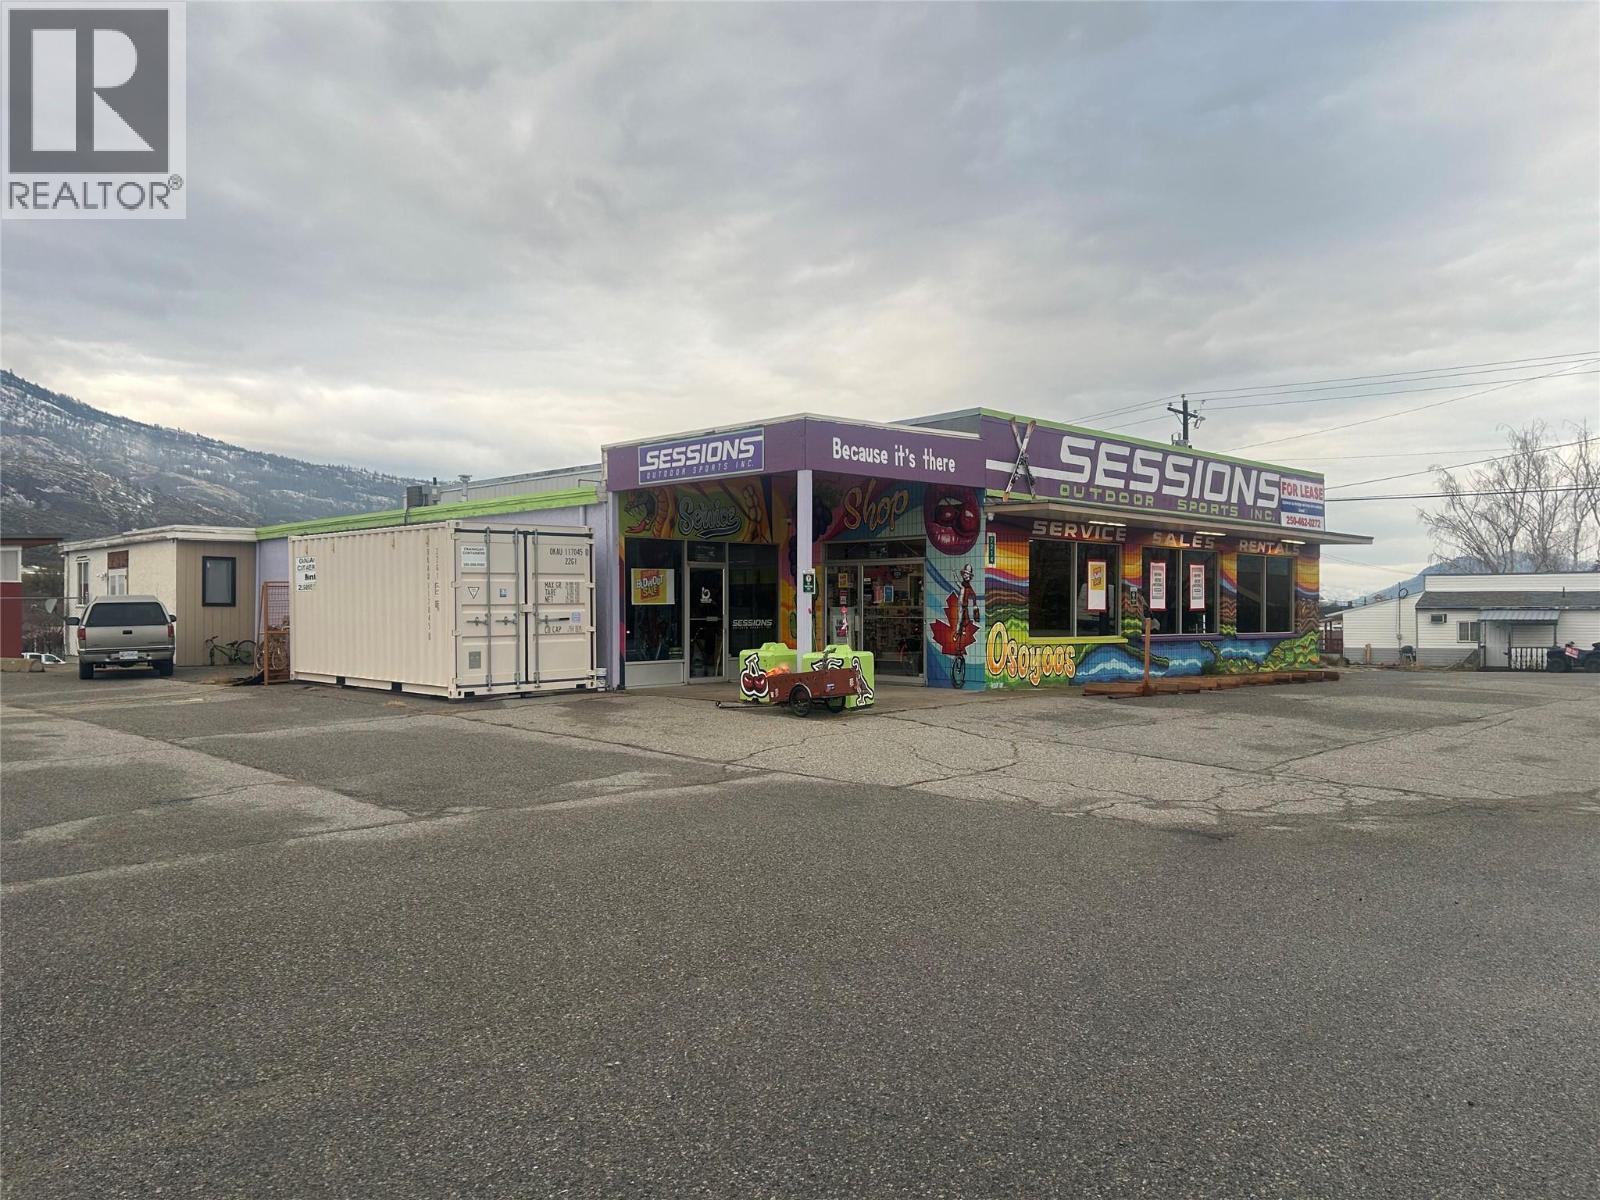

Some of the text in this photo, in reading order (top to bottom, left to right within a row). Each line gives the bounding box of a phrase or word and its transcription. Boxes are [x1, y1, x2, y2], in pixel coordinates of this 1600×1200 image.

[640, 436, 763, 471] SESSIONS
[832, 437, 956, 473] Because it's there
[646, 459, 755, 480] OUTDOOR SPORTS INC.
[1058, 434, 1281, 509] SESSIONS
[843, 477, 910, 532] Shop
[1059, 483, 1276, 521] OUTDOOR SPORTS INC.
[1281, 481, 1323, 500] FOR LEASE
[677, 495, 742, 538] Service
[1031, 519, 1127, 542] SERVICE
[1151, 530, 1216, 550] SALES
[1239, 538, 1300, 555] RENTALS
[641, 586, 658, 598] SALE
[732, 619, 773, 627] SESSIONS
[986, 620, 1076, 687] Osoyoos
